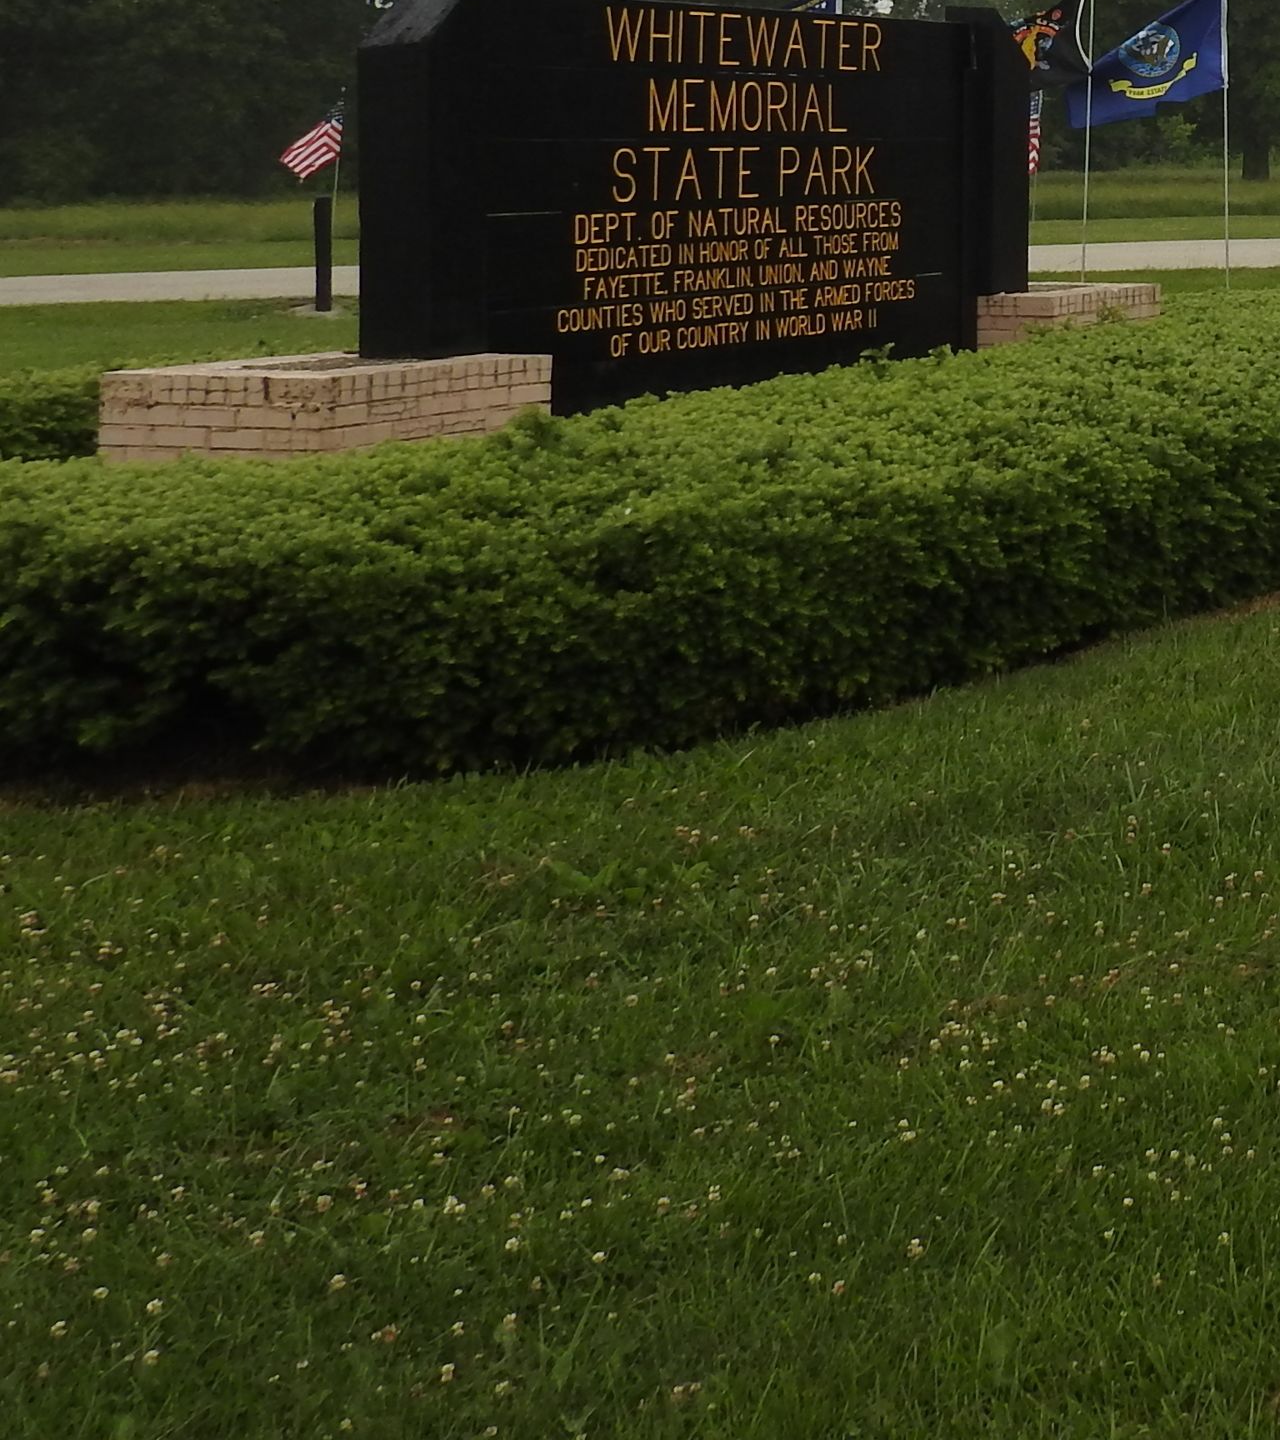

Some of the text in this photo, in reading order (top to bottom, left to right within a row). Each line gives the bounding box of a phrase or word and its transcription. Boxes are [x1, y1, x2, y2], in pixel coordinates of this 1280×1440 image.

[606, 6, 882, 71] WHITEWATER
[648, 78, 848, 132] MEMORIAL
[612, 145, 876, 203] STATE PARK
[574, 201, 902, 245] DEPT. OF NATURAL RESOURCES
[575, 231, 900, 273] DEDICATED IN HONOR OF ALL THOSE FROM
[809, 258, 839, 282] AND
[842, 255, 892, 279] WAYNE
[557, 278, 916, 334] COUNTIES WHO SERVED IN THE ARMED FORCES
[610, 307, 878, 358] OF OUR COUNTRY IN WORLD WAR II
